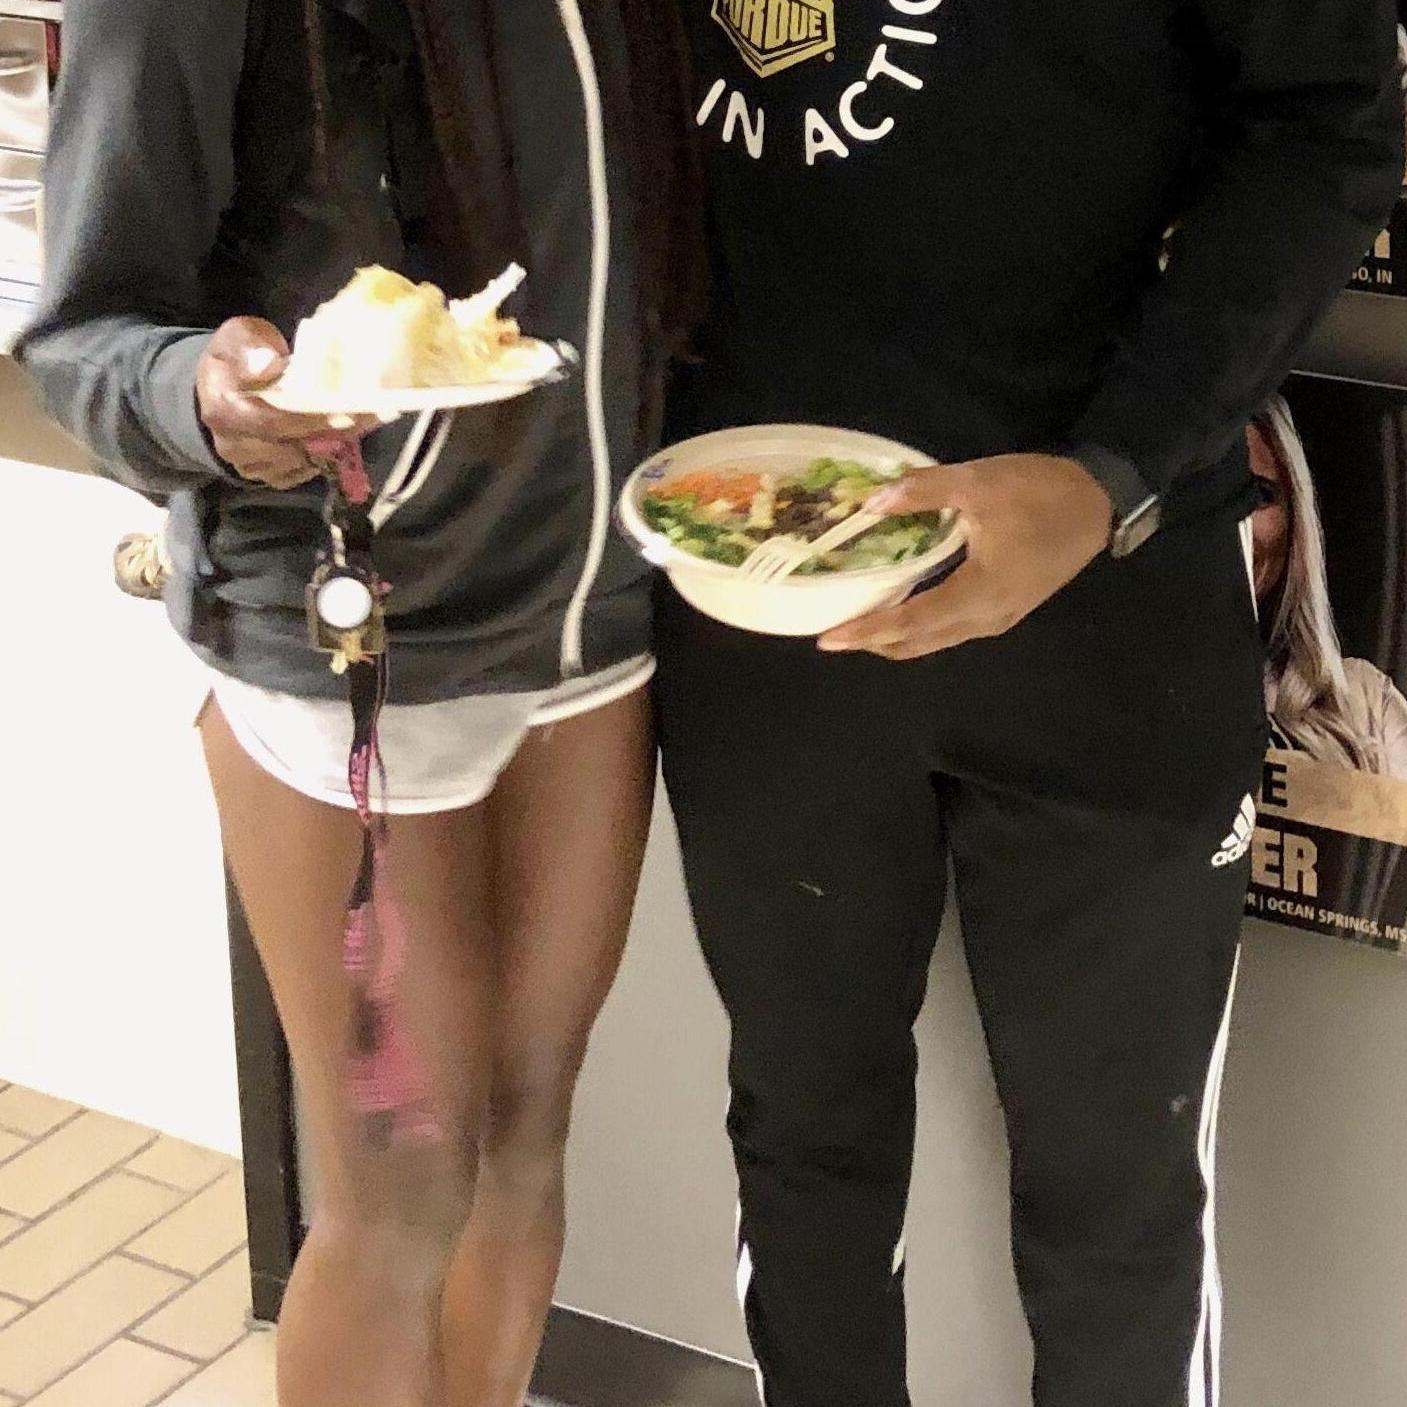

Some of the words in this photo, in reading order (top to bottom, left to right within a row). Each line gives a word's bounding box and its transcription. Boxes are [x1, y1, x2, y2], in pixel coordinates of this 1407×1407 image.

[696, 78, 765, 159] IN
[1376, 268, 1393, 284] IN
[1267, 898, 1315, 921] OCEAN
[1318, 909, 1382, 938] SPRINGS,
[1385, 925, 1407, 942] MS
